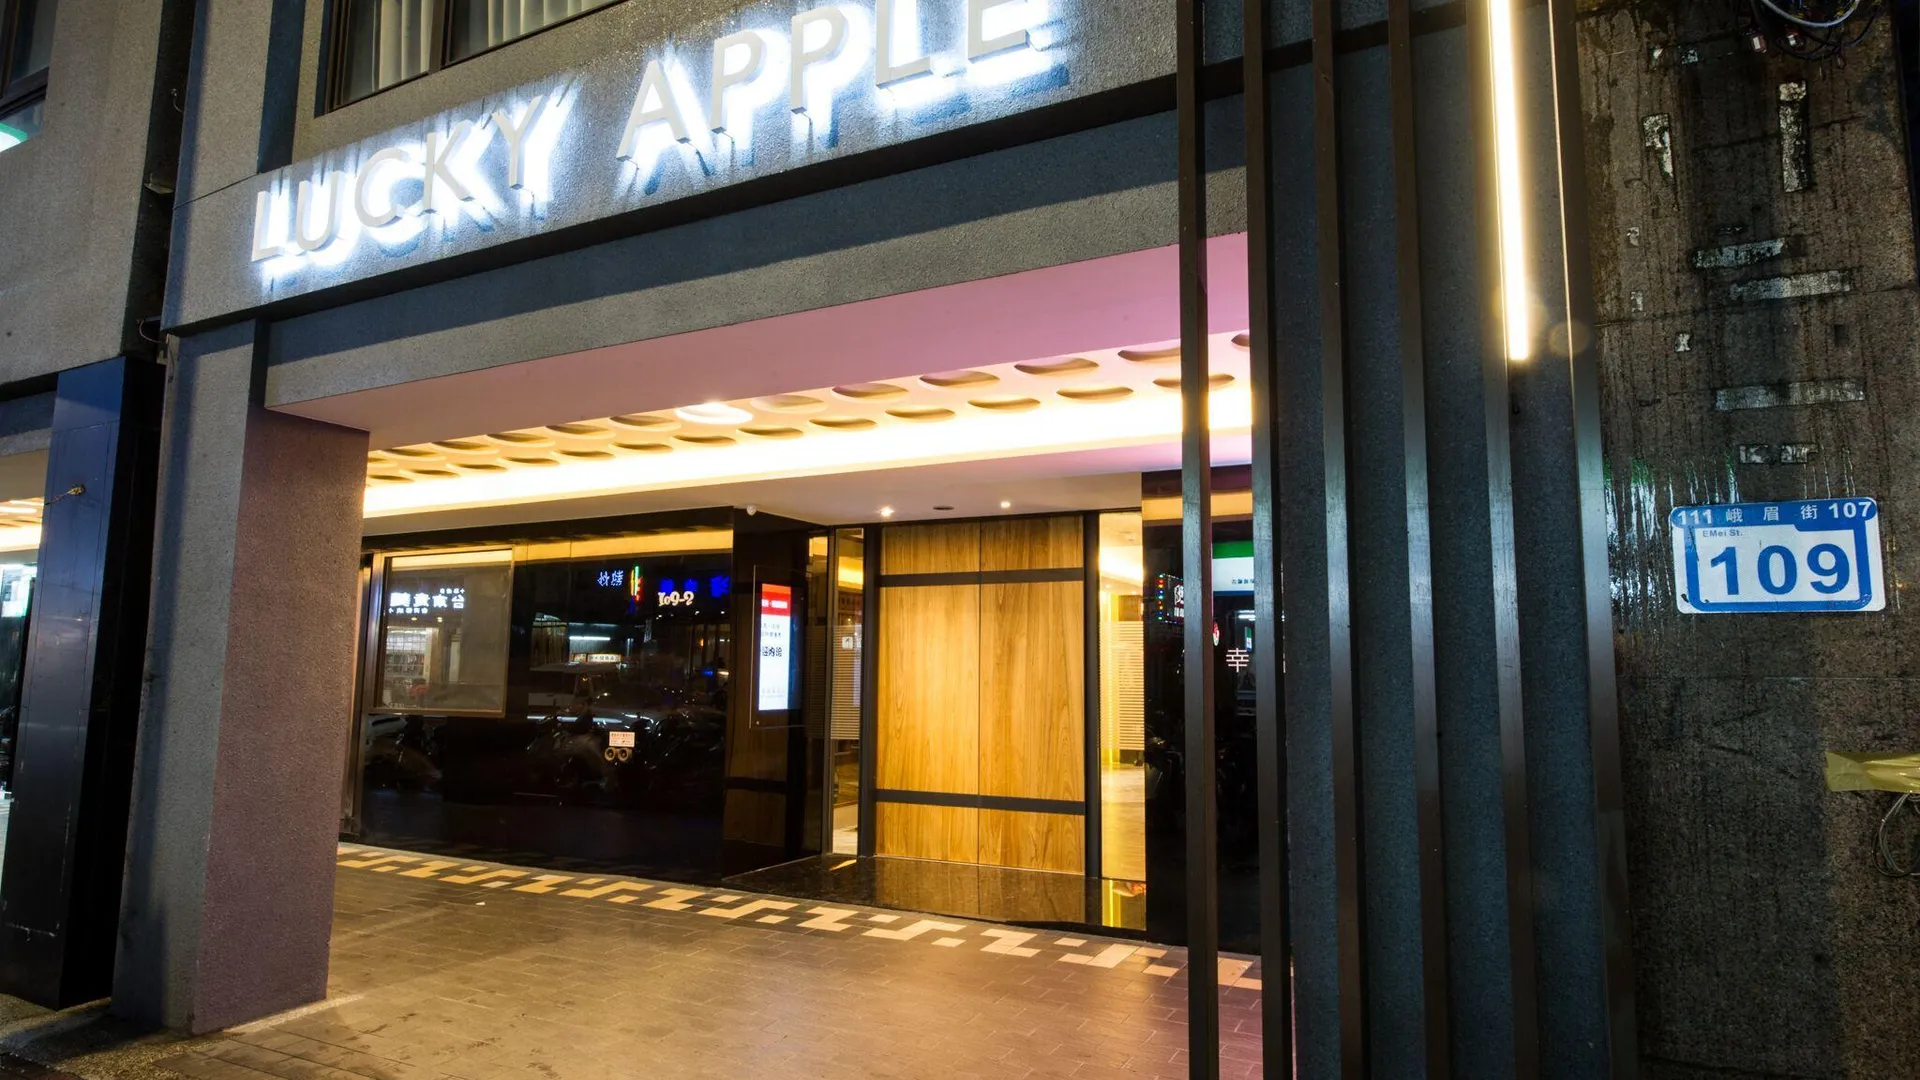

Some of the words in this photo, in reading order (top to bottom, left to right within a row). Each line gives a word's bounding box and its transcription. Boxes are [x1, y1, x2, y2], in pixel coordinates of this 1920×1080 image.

[252, 94, 544, 262] LUCKY
[616, 0, 1032, 162] APPLE
[1677, 508, 1713, 525] 111
[1725, 504, 1818, 523] 峨眉街
[1828, 501, 1873, 519] 107
[1703, 530, 1727, 538] EMei
[1729, 529, 1743, 538] St.
[1710, 543, 1850, 596] 109
[1225, 647, 1250, 673] 幸
